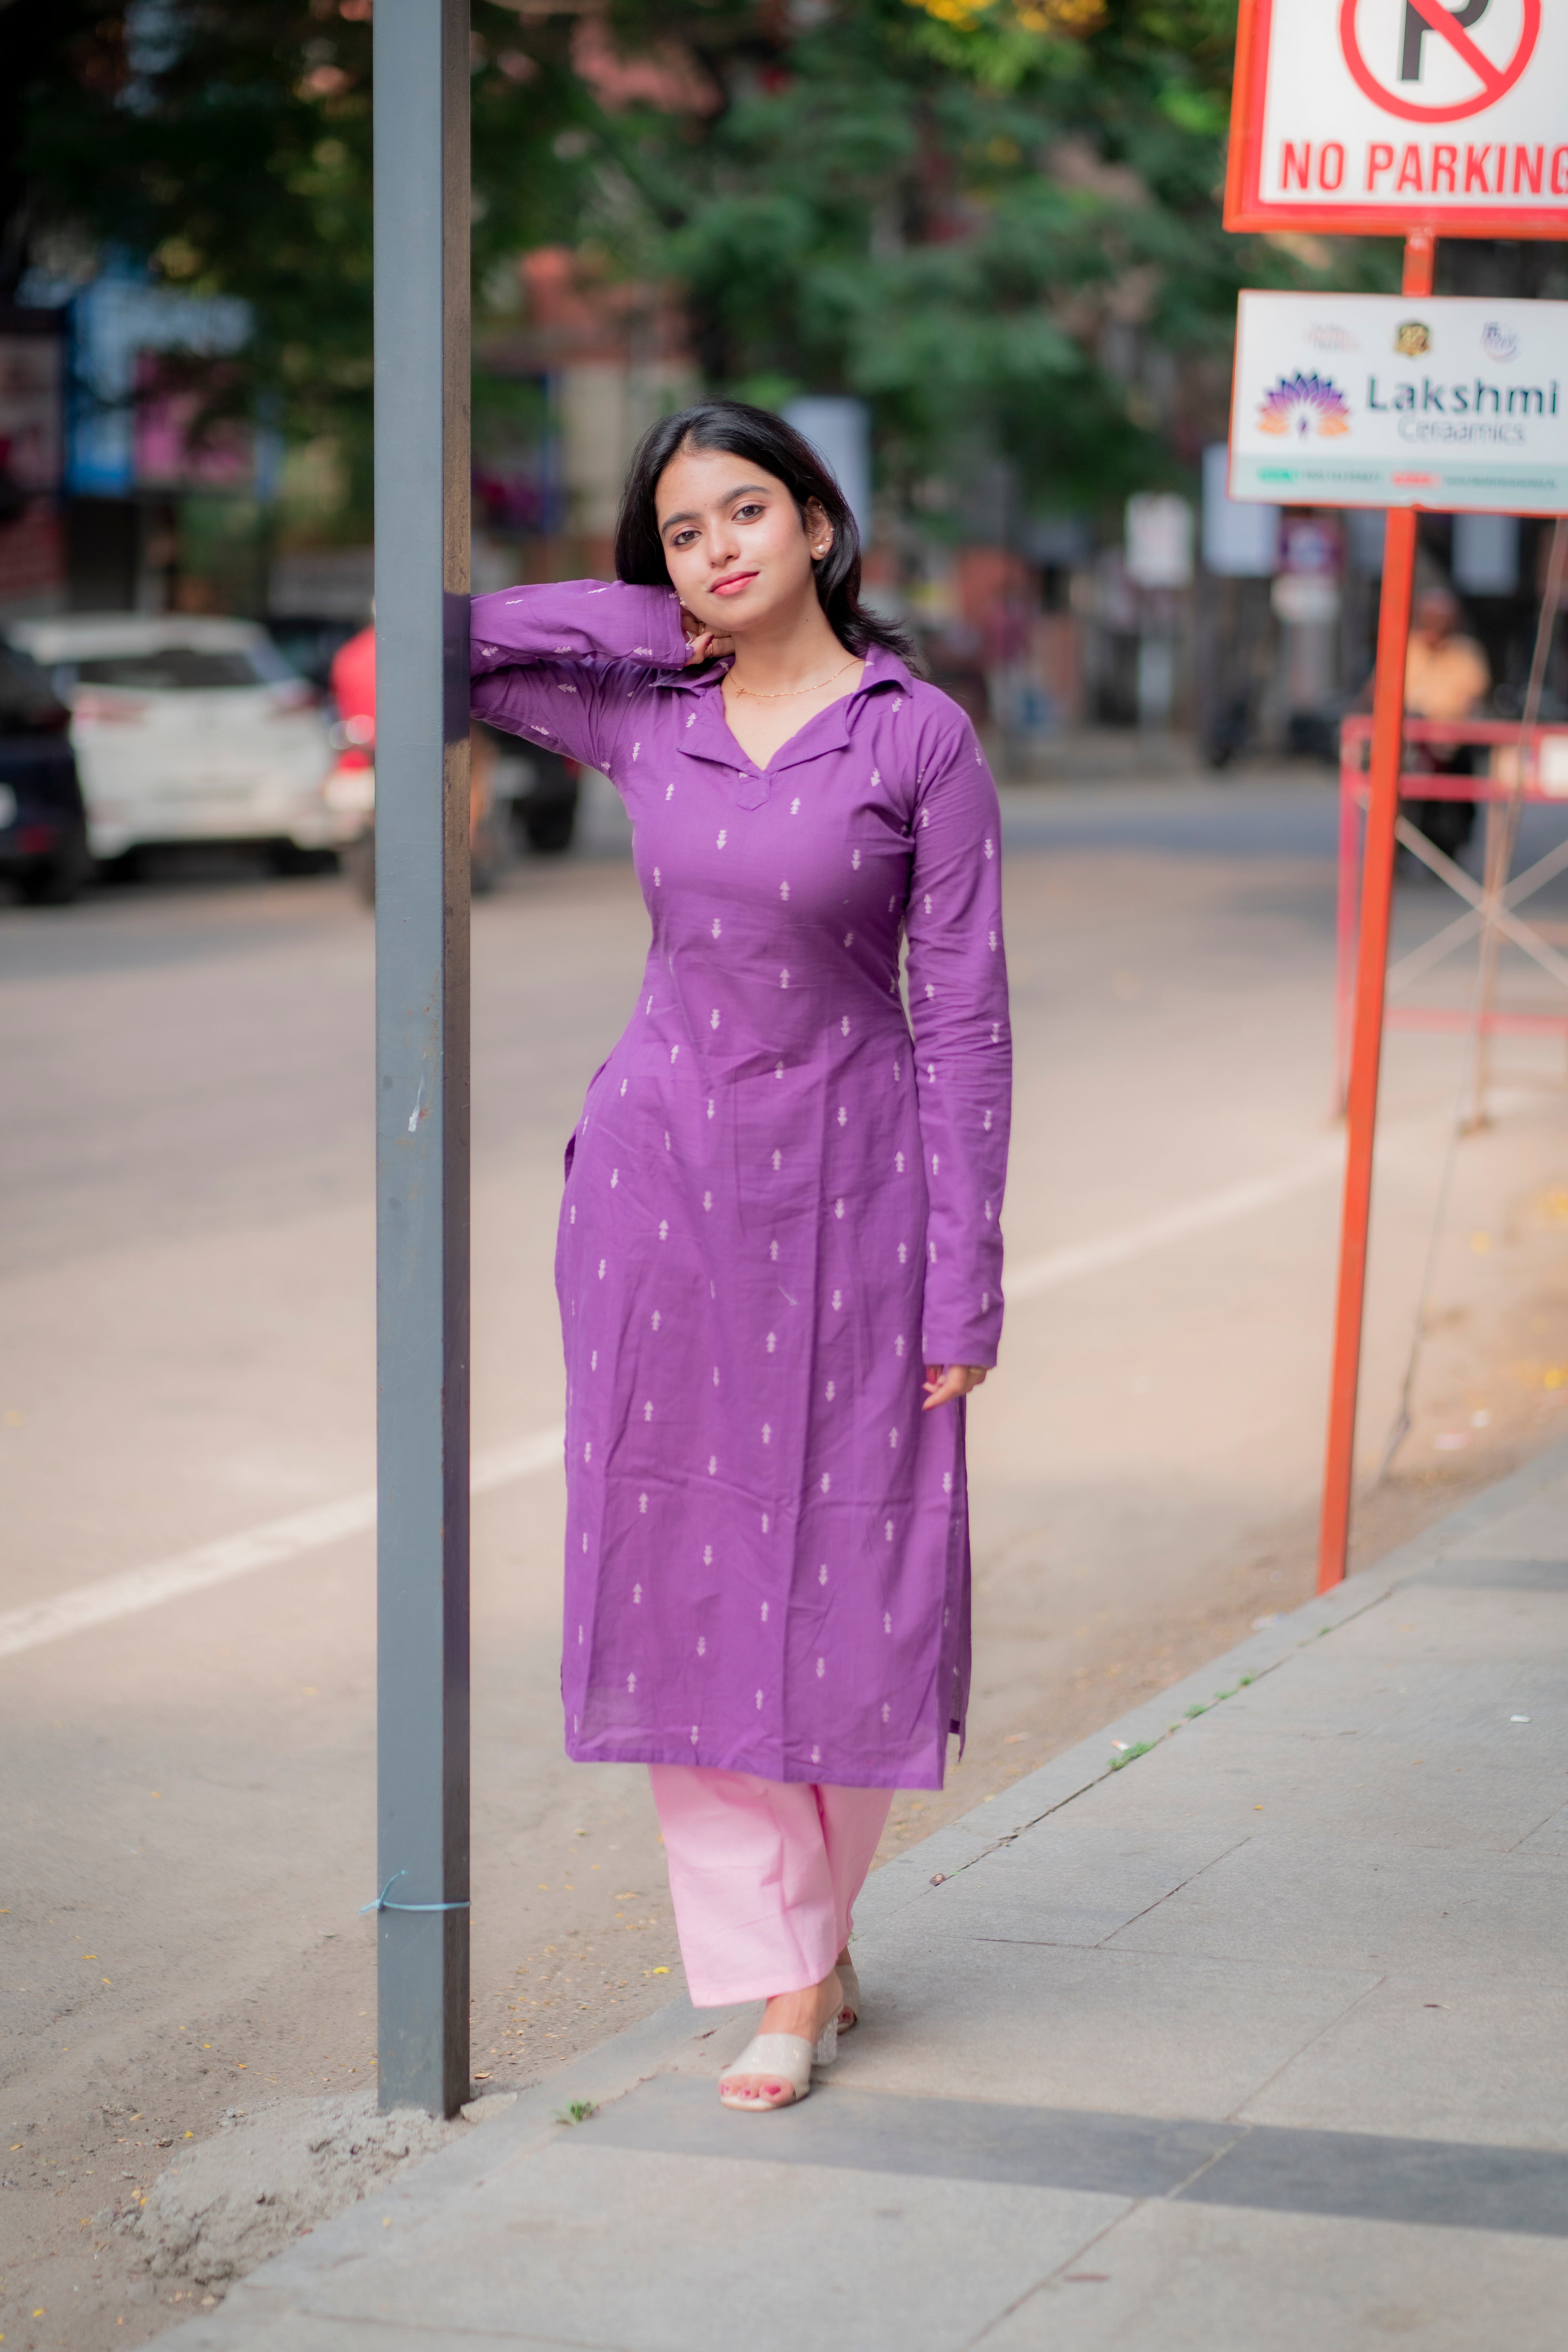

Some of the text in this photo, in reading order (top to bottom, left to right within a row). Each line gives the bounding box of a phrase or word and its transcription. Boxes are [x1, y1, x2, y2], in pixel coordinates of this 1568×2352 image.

[1281, 141, 1568, 195] NO PARKING
[1368, 376, 1560, 416] Lakshmi
[1397, 416, 1527, 445] Ceraamics
